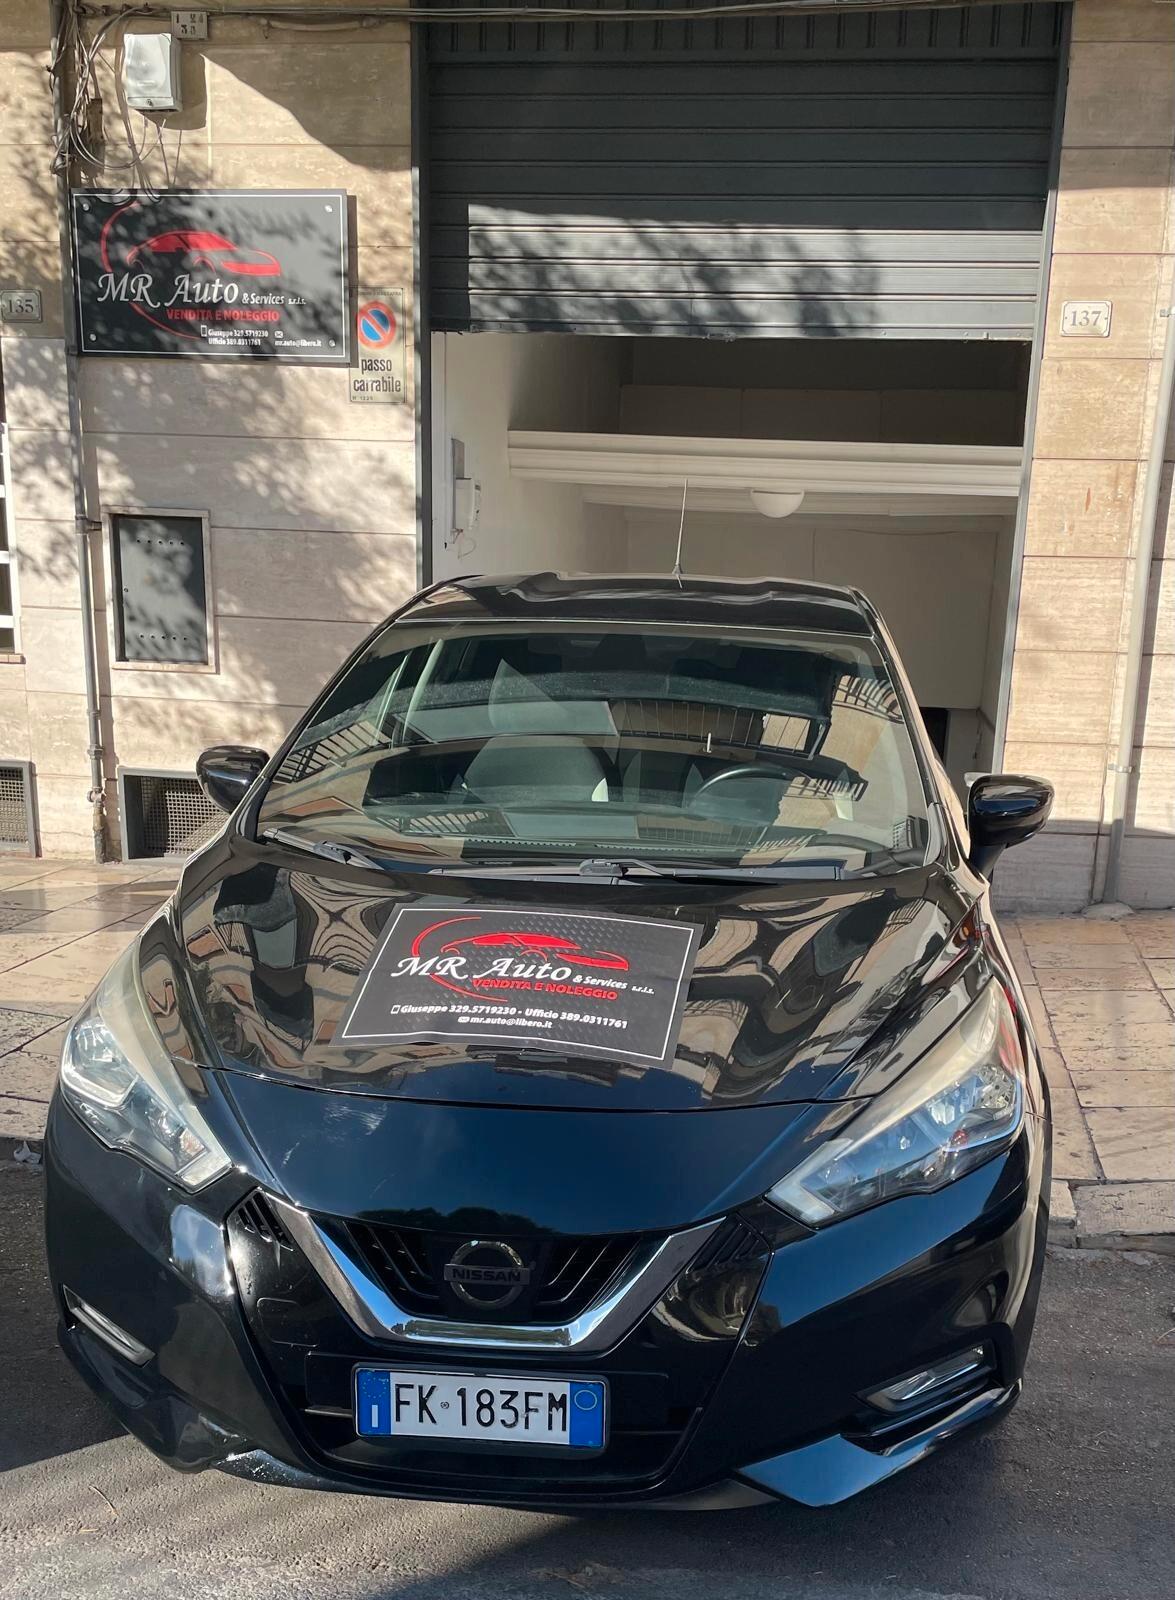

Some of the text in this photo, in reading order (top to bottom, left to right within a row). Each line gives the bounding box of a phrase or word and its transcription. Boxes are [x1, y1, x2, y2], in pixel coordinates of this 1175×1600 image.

[97, 272, 161, 308] MR
[164, 273, 239, 307] Auto
[242, 292, 249, 304] &
[250, 292, 285, 305] Services
[8, 298, 34, 313] 135
[166, 308, 280, 322] VENDITA E NOLEGGIO
[1070, 310, 1102, 326] 137
[361, 358, 393, 374] passo
[353, 376, 402, 393] carrabile
[390, 956, 469, 980] MR
[472, 957, 572, 981] Auto
[572, 974, 583, 984] &
[583, 976, 629, 990] Services
[471, 979, 619, 1000] VENDITA E NOLEGGIO
[400, 1004, 449, 1015] Giuseppe
[448, 1004, 518, 1016] 329.5719230
[524, 1007, 560, 1020] Ufficio
[559, 1011, 629, 1030] 389.0311761
[470, 1016, 553, 1029] mr.auto@libero.it
[452, 1268, 521, 1283] NISSAN
[395, 1383, 438, 1425] FK
[456, 1387, 568, 1432] 183FM
